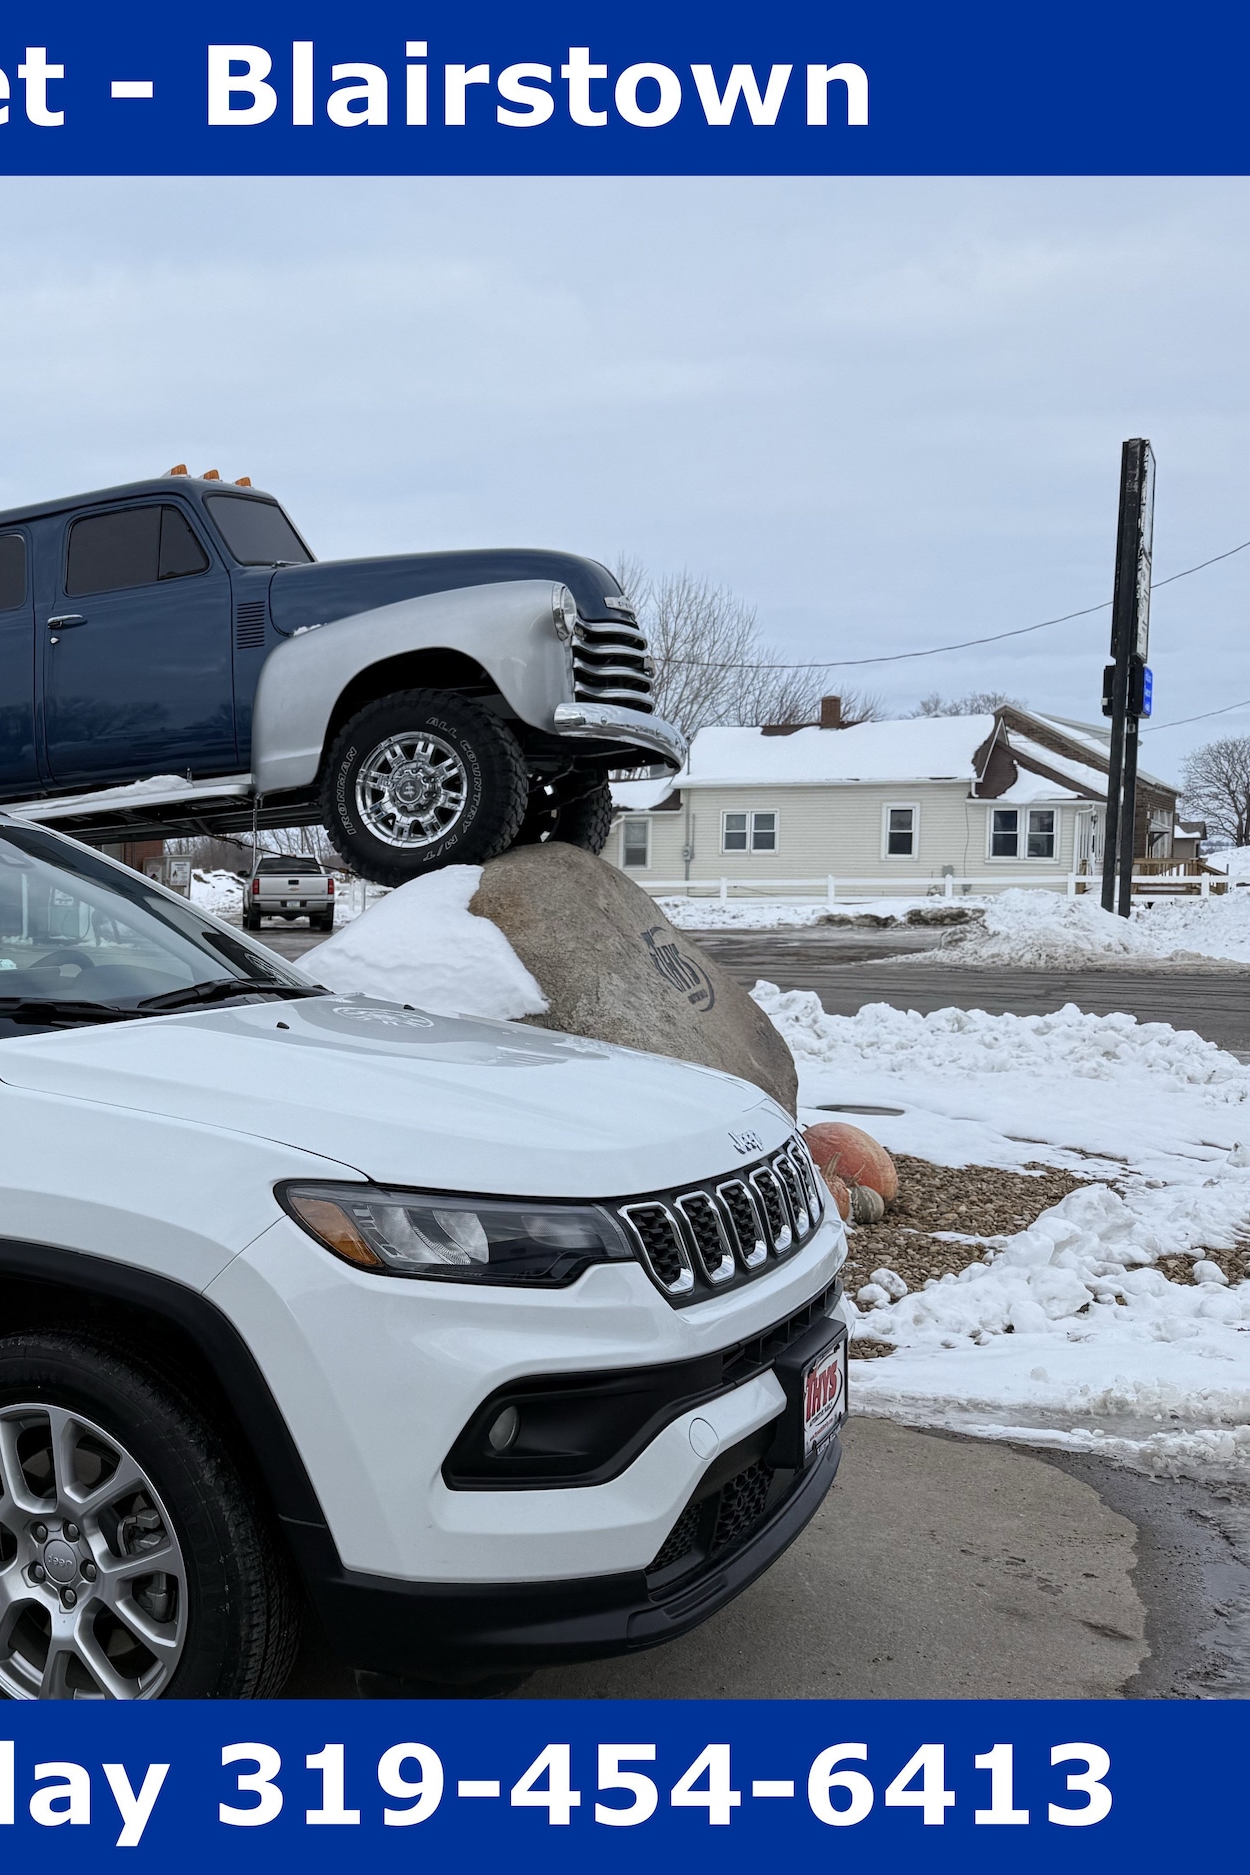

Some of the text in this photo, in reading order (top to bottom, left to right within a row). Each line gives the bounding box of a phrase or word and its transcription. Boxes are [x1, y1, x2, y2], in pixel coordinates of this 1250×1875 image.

[336, 746, 358, 836] IRONMAN
[426, 716, 458, 740] ALL
[459, 738, 483, 835] COUNTRY
[805, 1360, 838, 1424] THYS
